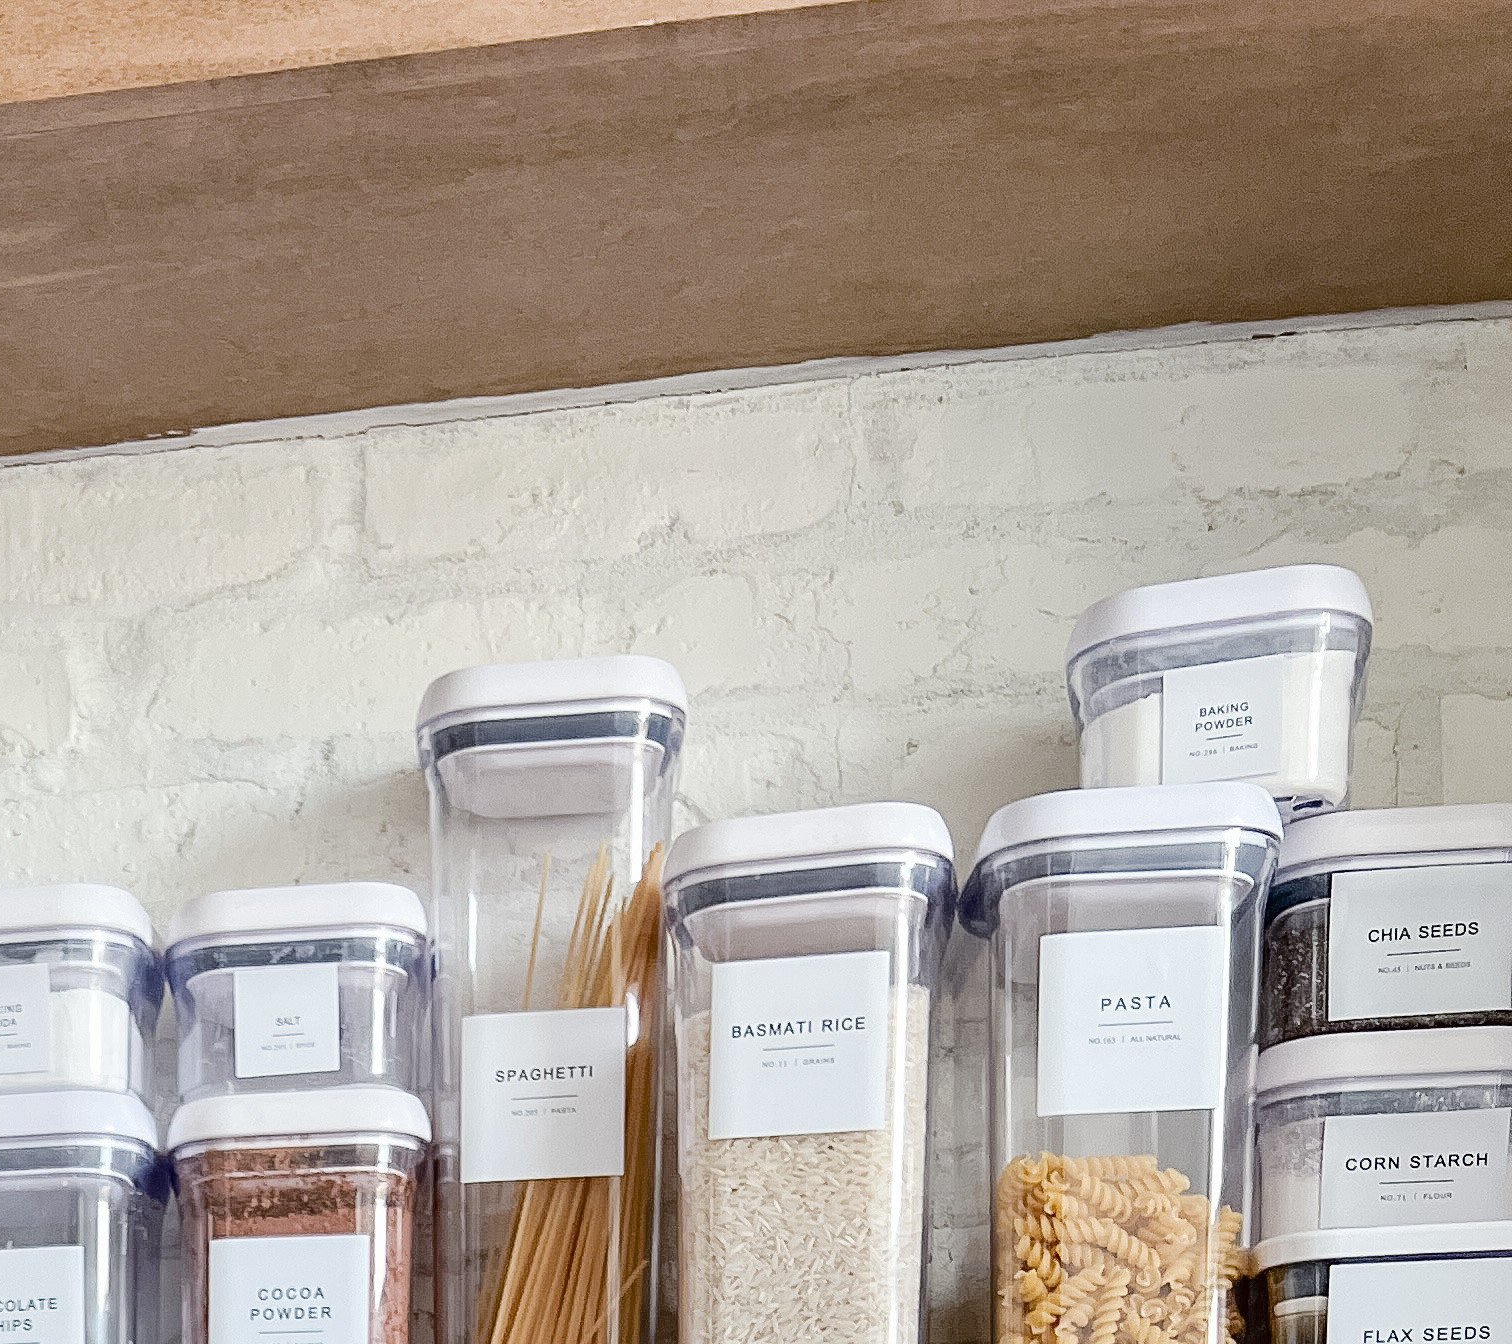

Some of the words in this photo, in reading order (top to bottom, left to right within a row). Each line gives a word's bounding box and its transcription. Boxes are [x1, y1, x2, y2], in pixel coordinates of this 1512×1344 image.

[1199, 701, 1249, 717] BAKING
[1195, 715, 1253, 733] POWDER
[1229, 743, 1258, 753] BAKING
[1368, 927, 1411, 943] CHIA
[1418, 921, 1479, 939] SEEDS
[1414, 963, 1435, 971] NUTS
[1437, 962, 1443, 970] &
[1100, 995, 1172, 1012] PASTA
[274, 1015, 301, 1027] SALT
[731, 1020, 813, 1039] BASMATI
[821, 1016, 866, 1033] RICE
[1146, 1034, 1182, 1042] NATURAL
[802, 1057, 836, 1066] GRAINS
[495, 1065, 594, 1083] SPAGHETTI
[1345, 1156, 1400, 1171] CORN
[1409, 1152, 1489, 1169] STARCH
[1423, 1192, 1452, 1200] FLOUR
[257, 1287, 326, 1301] COCOA
[249, 1306, 333, 1321] POWDER
[1363, 1328, 1413, 1344] FLAX
[1422, 1325, 1491, 1342] SEEDS
